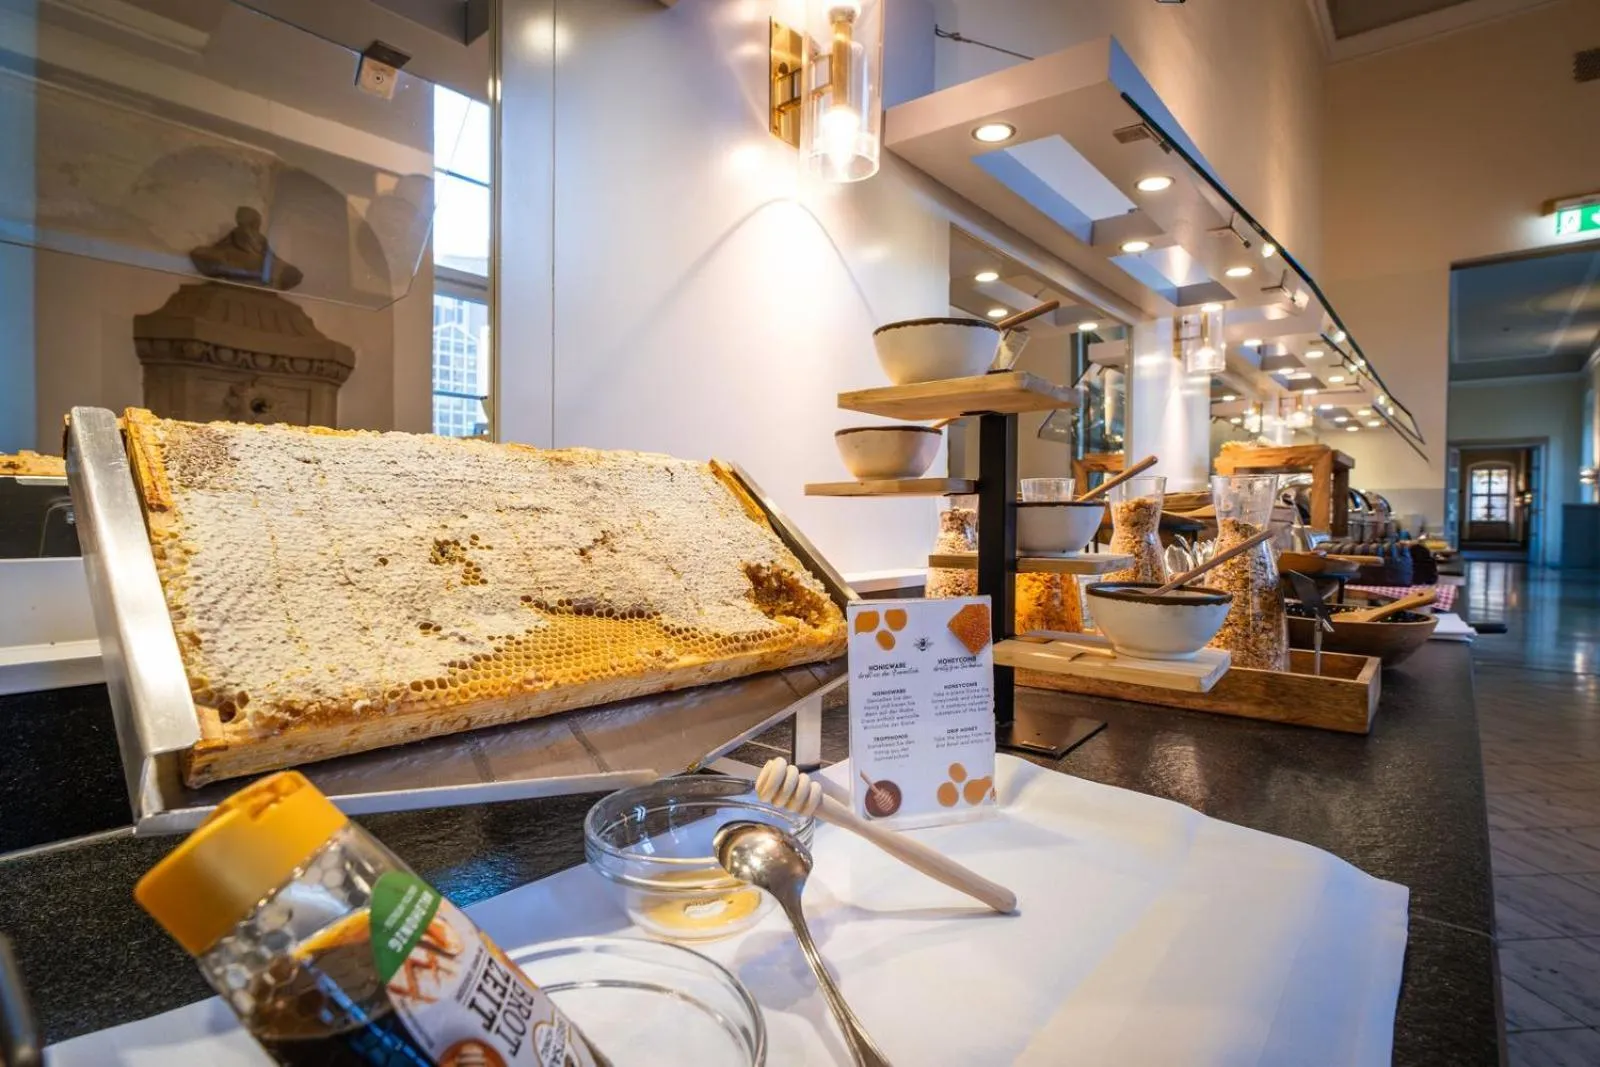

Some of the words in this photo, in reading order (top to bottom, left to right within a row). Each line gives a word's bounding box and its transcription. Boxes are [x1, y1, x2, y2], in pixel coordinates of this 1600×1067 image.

[937, 656, 977, 664] HONEYCOMB
[944, 681, 977, 689] HONEYCOMB
[467, 957, 511, 1032] ZEIT
[495, 979, 535, 1058] BROT
